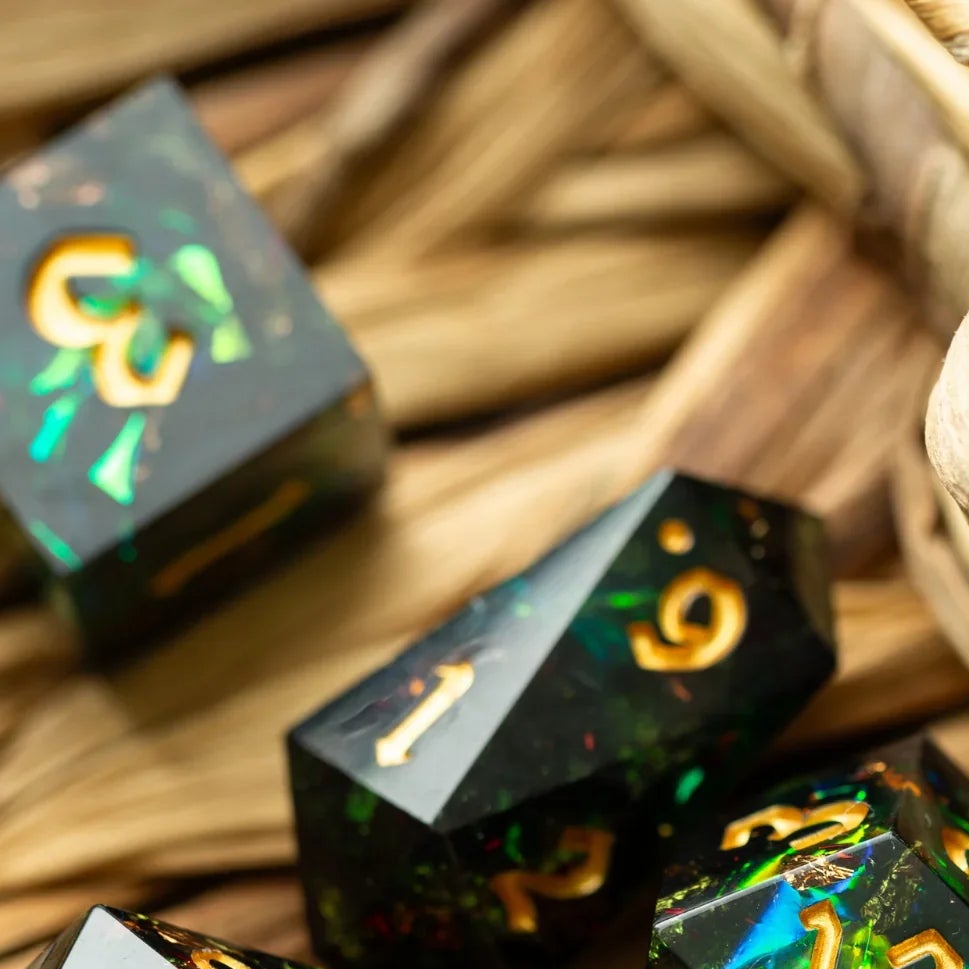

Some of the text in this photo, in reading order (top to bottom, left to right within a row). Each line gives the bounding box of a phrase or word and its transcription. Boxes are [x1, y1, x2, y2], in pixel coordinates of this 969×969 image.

[28, 232, 196, 408] 3
[374, 661, 476, 769] 1
[719, 800, 871, 852] 3
